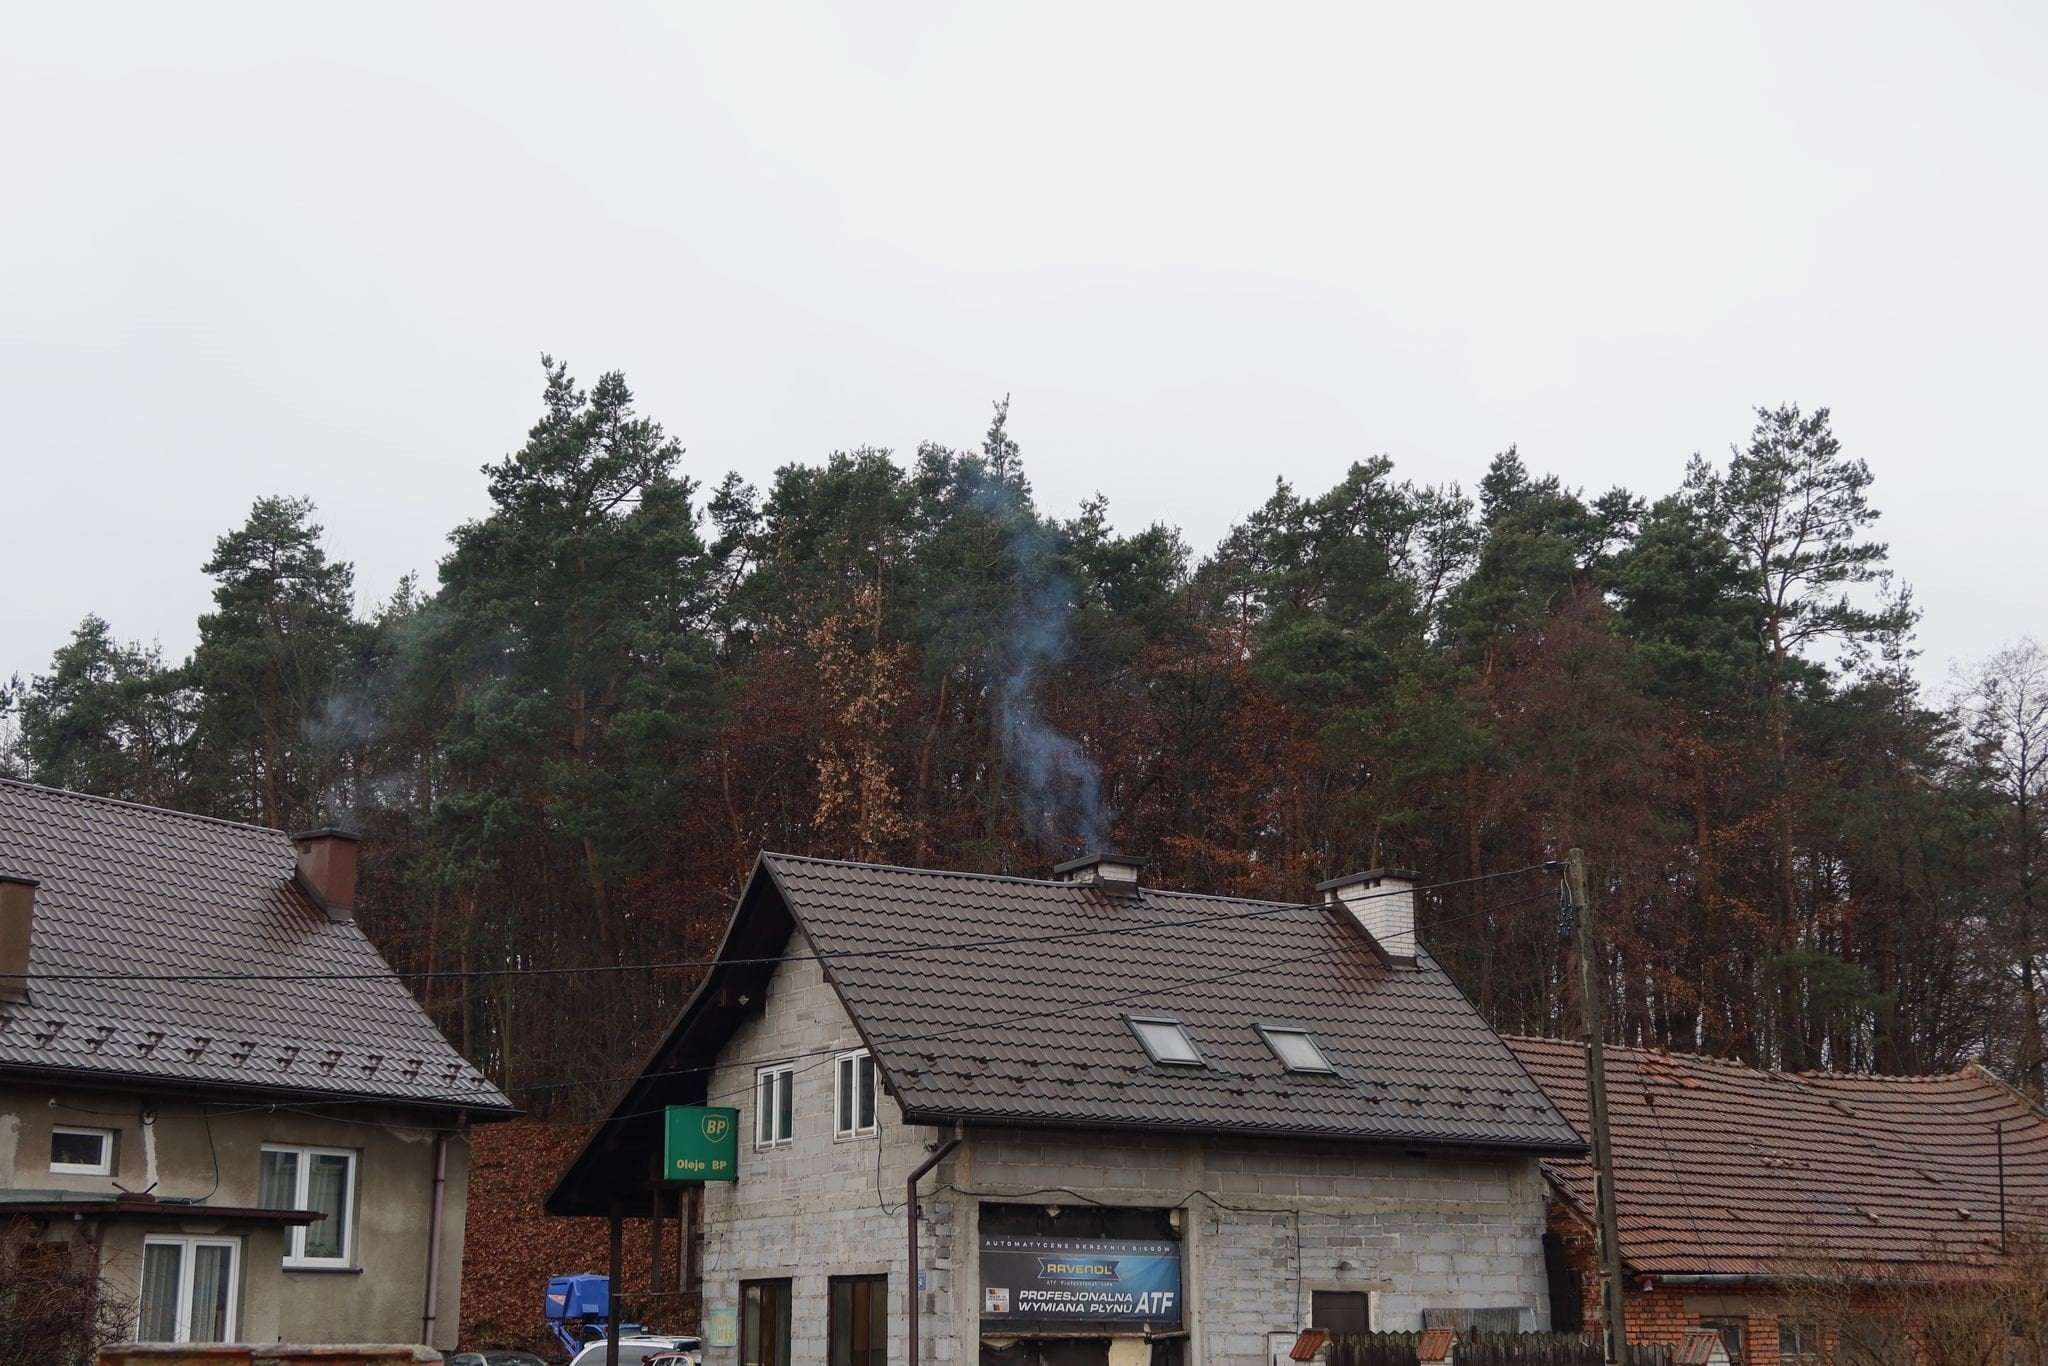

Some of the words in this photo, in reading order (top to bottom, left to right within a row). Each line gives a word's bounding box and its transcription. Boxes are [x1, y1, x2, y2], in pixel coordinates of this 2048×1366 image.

[707, 1119, 726, 1134] BP
[676, 1159, 705, 1172] Oleje
[712, 1160, 727, 1170] BP
[1047, 1263, 1112, 1275] RAVENOL
[1019, 1290, 1133, 1302] PROFESJONALNA
[1018, 1301, 1085, 1313] WYMIANA
[1089, 1303, 1133, 1313] PŁYNU
[1134, 1291, 1174, 1314] ATF
